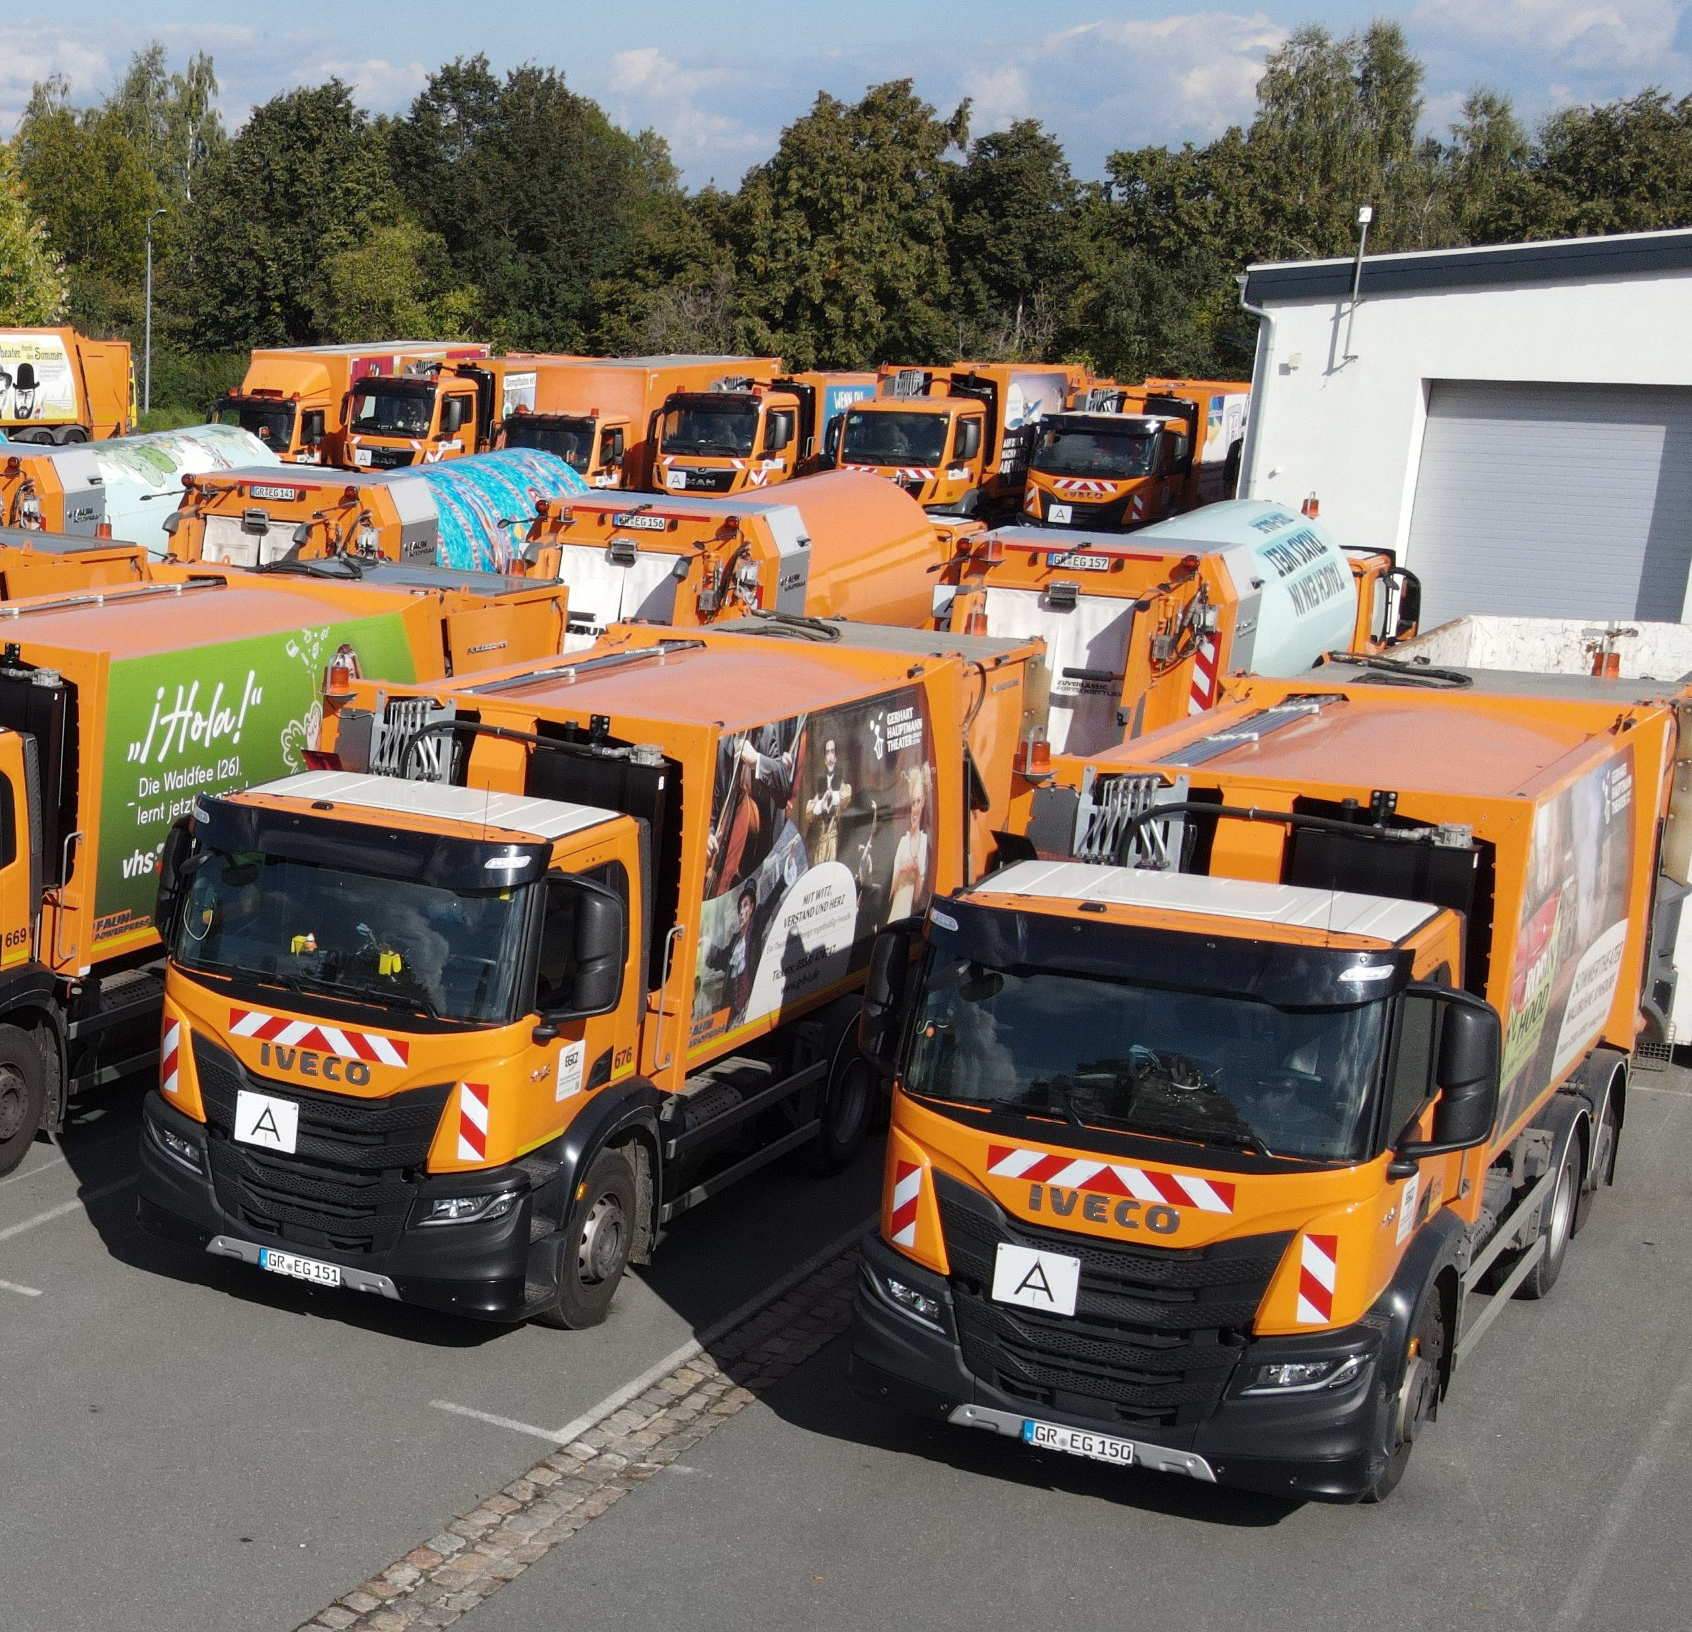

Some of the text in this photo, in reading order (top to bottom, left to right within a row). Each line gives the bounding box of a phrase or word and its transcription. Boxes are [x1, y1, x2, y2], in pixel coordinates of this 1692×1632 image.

[35, 347, 63, 360] Sommer
[358, 453, 367, 463] A
[671, 474, 681, 485] A
[648, 516, 664, 528] 156
[1054, 509, 1065, 520] A
[1073, 556, 1087, 567] EG
[1088, 558, 1108, 569] 157
[886, 707, 914, 726] GERHART
[886, 718, 923, 740] HAUPTMANN
[886, 735, 913, 753] THEATER
[138, 777, 160, 797] Die
[163, 766, 214, 793] Waldfee
[137, 795, 196, 825] lernt jetzt
[122, 849, 155, 879] vhs
[95, 912, 131, 931] FAUN
[783, 894, 846, 928] VERSTAND UND HERZ
[5, 927, 27, 948] 669
[260, 1042, 371, 1086] IVECO
[614, 1046, 633, 1070] 676
[250, 1103, 281, 1142] A
[1028, 1183, 1181, 1235] IVECO
[268, 1252, 339, 1283] GR EG 151
[1013, 1260, 1055, 1303] A
[1035, 1425, 1131, 1461] GR EG 150
